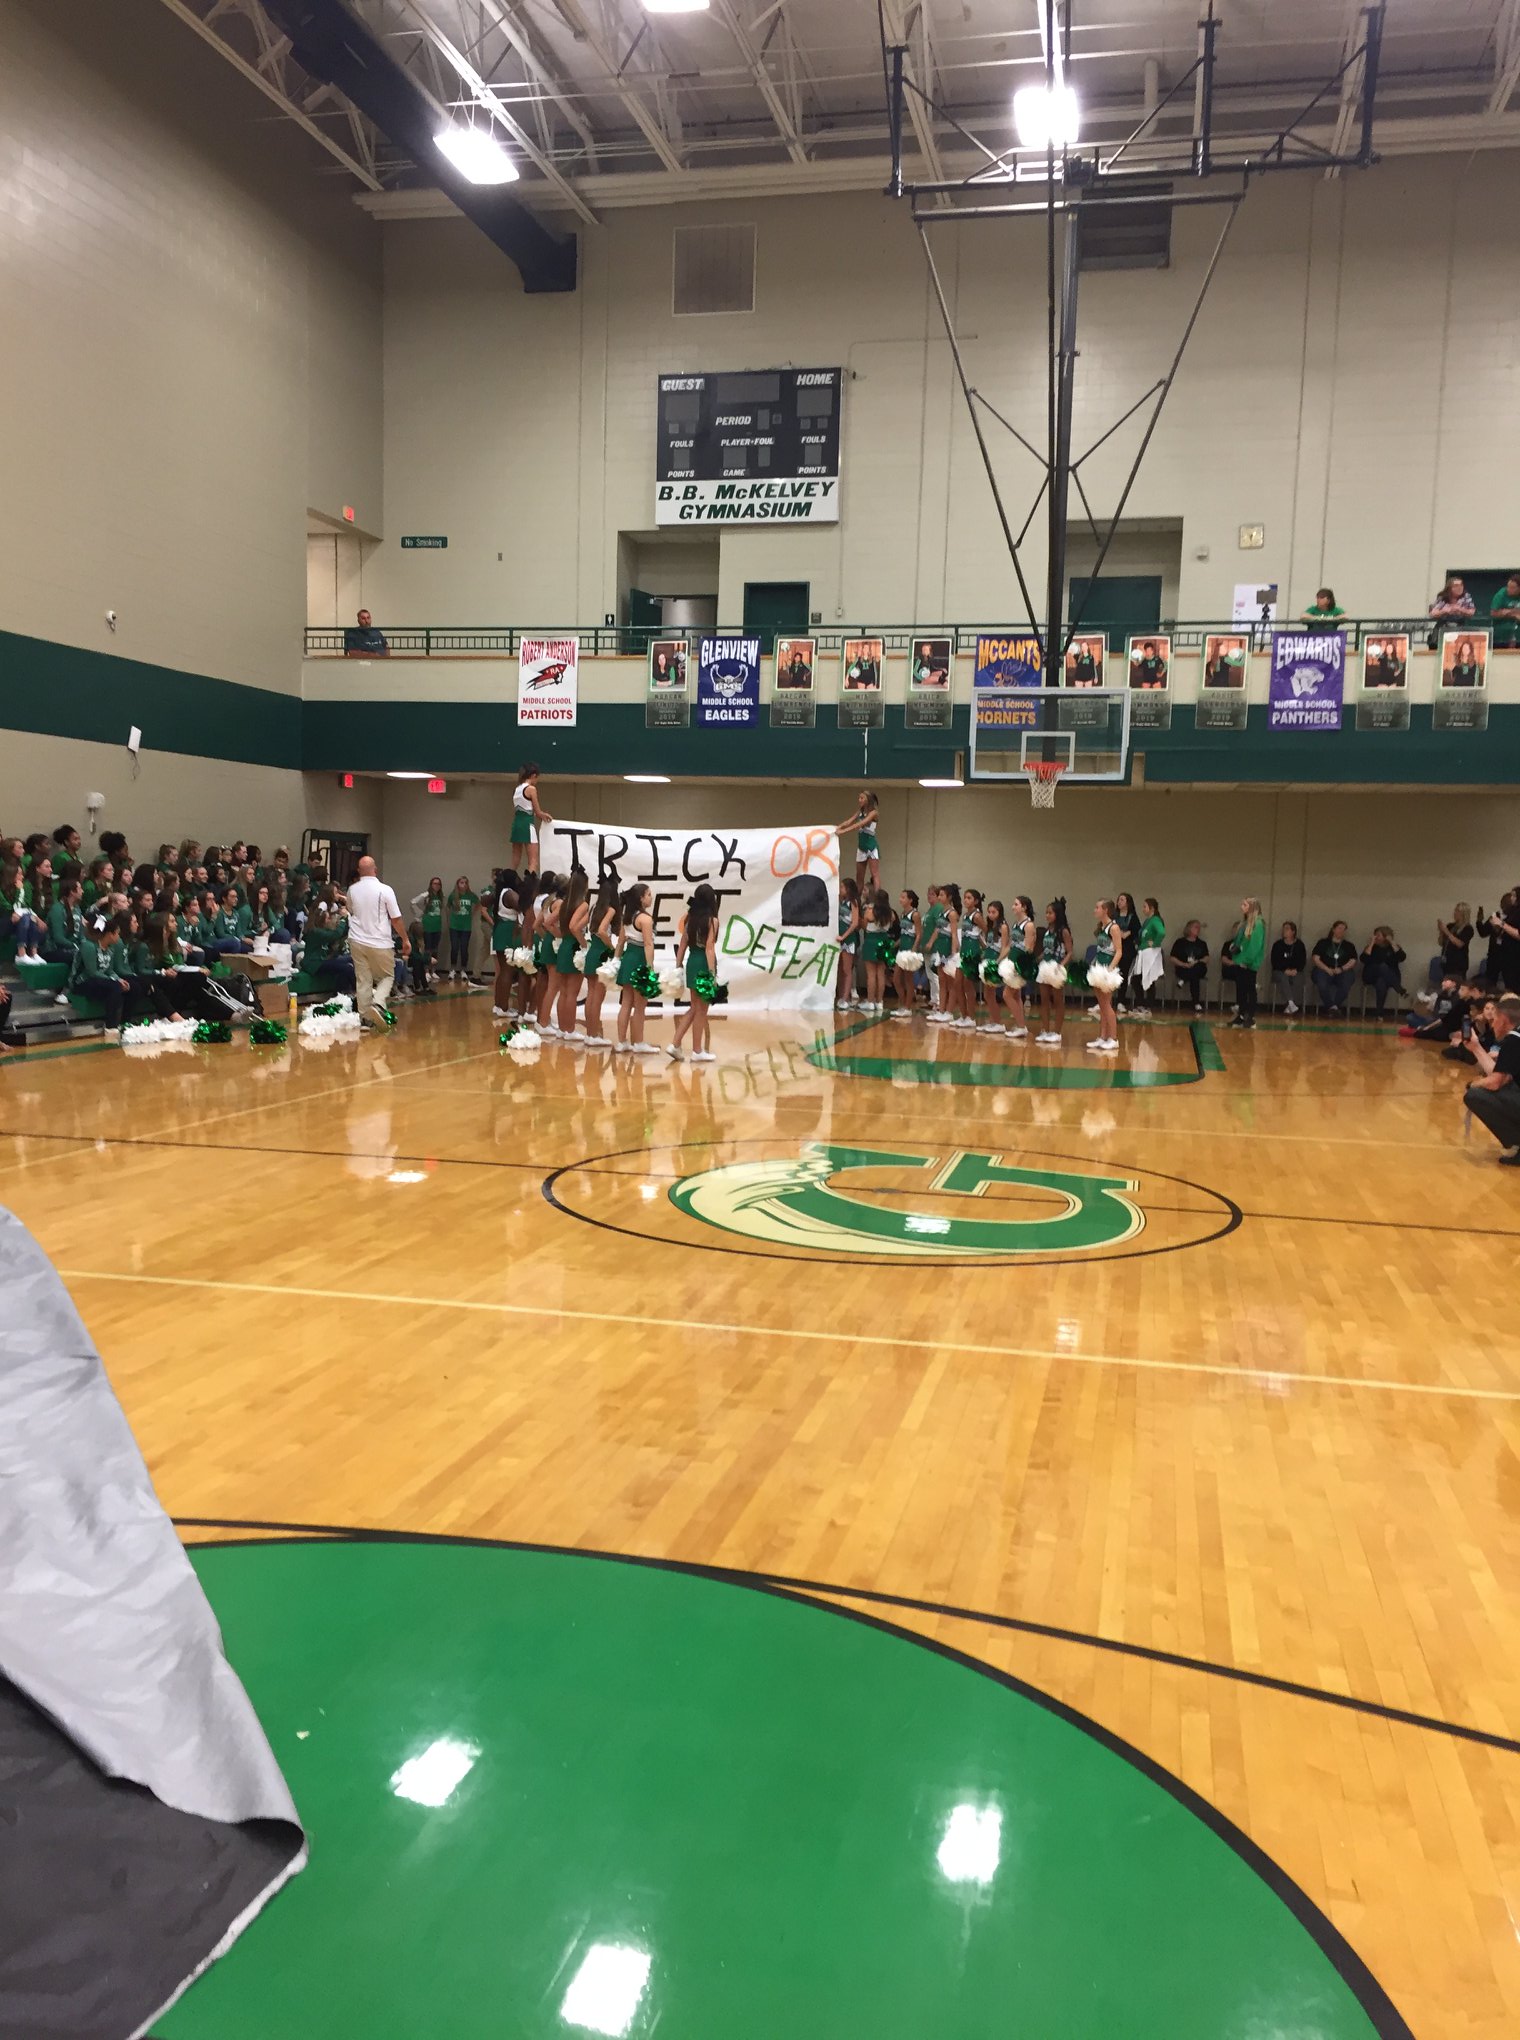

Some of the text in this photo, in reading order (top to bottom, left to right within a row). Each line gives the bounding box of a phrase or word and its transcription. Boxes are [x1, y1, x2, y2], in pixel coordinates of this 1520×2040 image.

[662, 379, 703, 391] GUEST
[797, 373, 834, 385] HOME
[715, 416, 752, 426] PERIOD
[670, 440, 694, 448] FOULS
[801, 435, 826, 444] FOULS
[667, 469, 695, 478] POINTS
[723, 468, 745, 477] GAME
[798, 466, 827, 474] POINTS
[658, 481, 835, 501] B.B. McKELVEY
[679, 502, 812, 519] GYMNASIUM
[405, 538, 442, 548] No Smoking
[522, 640, 576, 667] ROBERT ANDERSON
[701, 640, 759, 668] GLENVIEW
[978, 639, 1042, 673] MCCANTS
[1276, 636, 1341, 671] EDWARDS
[977, 700, 1034, 708] MIDDLE SCHOOL
[1274, 700, 1337, 709] MIDDLE SCHOOL
[521, 709, 573, 719] PATRIOTS
[706, 709, 750, 720] EAGLES
[976, 711, 1036, 725] HORNETS
[1272, 710, 1338, 724] PANTHERS
[554, 828, 838, 884] TRICK OR
[722, 914, 841, 987] DEFEAT
